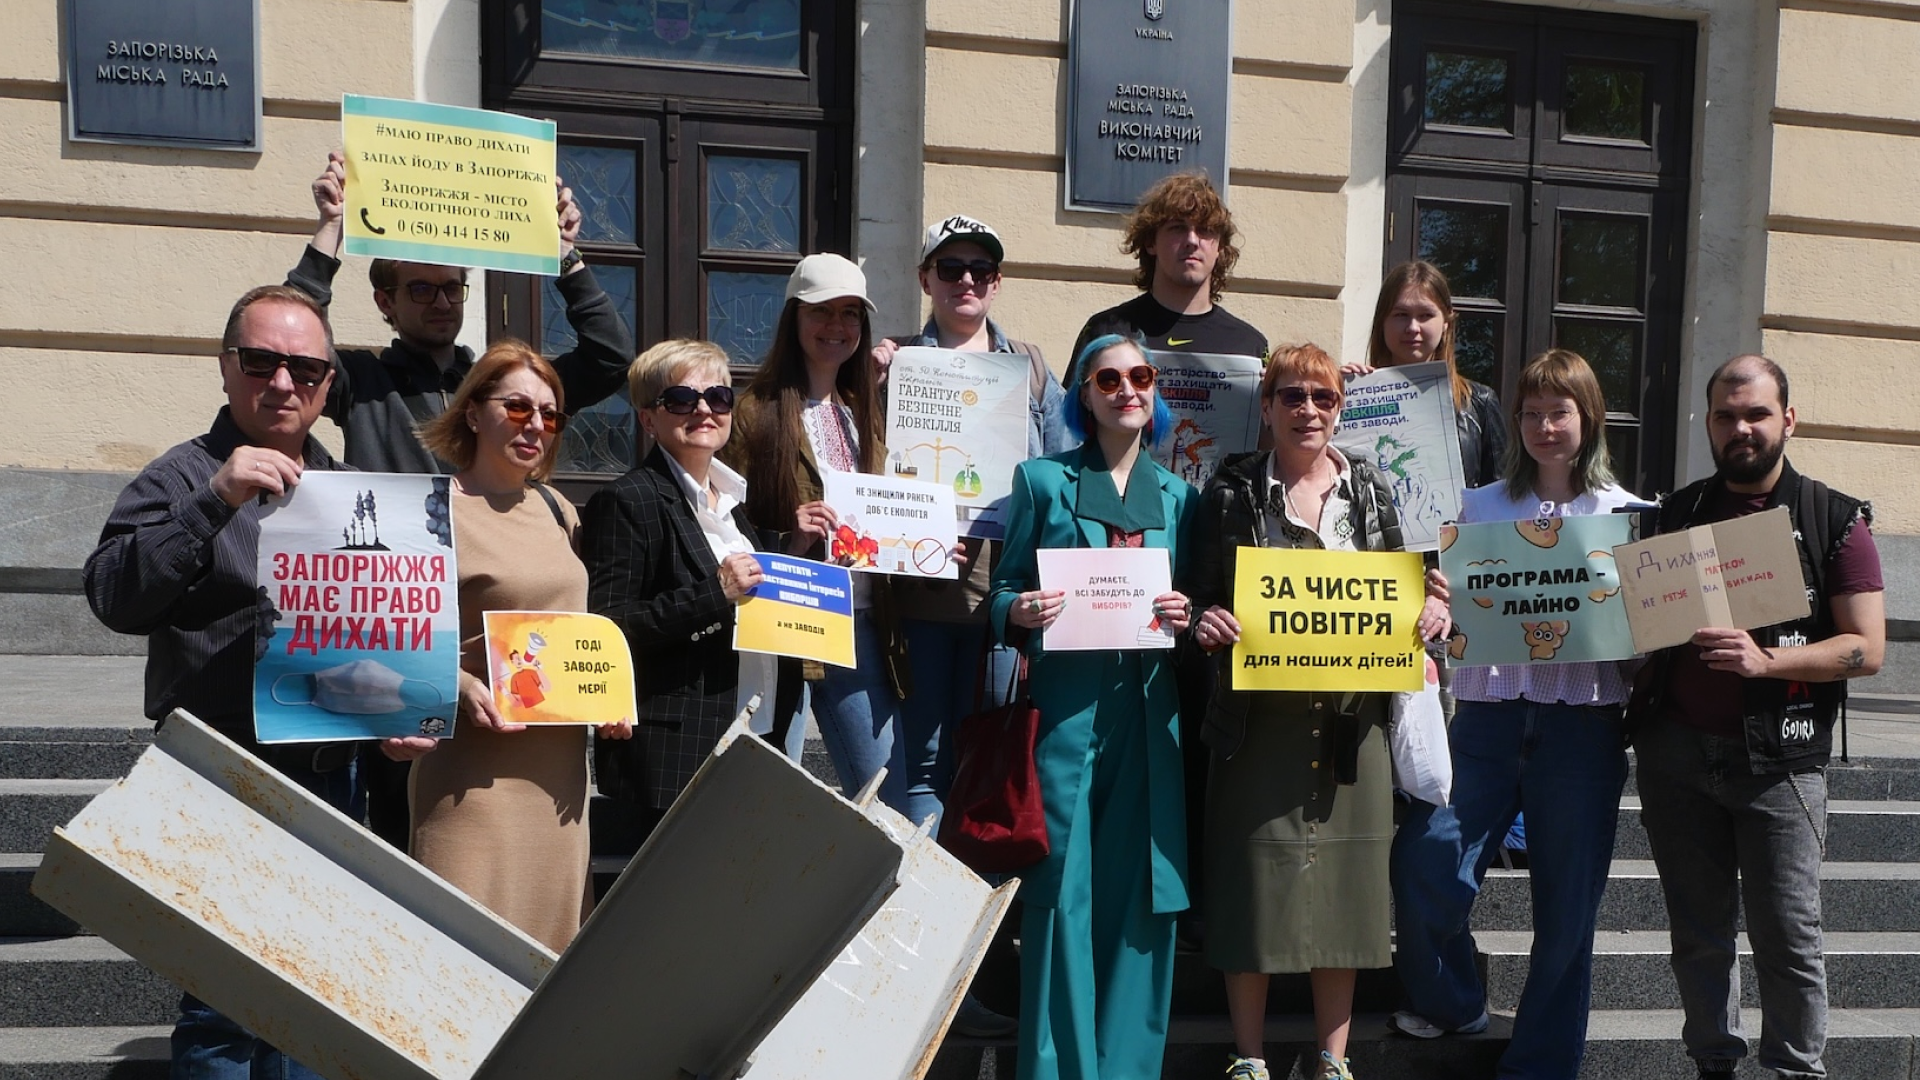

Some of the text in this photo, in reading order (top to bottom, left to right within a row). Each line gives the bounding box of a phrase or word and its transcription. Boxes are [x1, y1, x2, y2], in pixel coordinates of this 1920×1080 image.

[1135, 27, 1173, 40] УКРАЇНА
[108, 40, 218, 61] ЗАПОРІЗЬКА
[98, 65, 229, 87] МІСЬКА РАДА
[1117, 83, 1188, 100] ЗАПОРІЗЬКА
[1109, 100, 1195, 118] МІСЬКА РАДА
[1100, 119, 1202, 141] ВИКОНАВЧИЙ
[1117, 142, 1183, 161] КОМІТЕТ
[397, 219, 510, 243] 0 (50) 414 15 80
[898, 384, 960, 403] ГАРАНТУЄ
[1168, 379, 1232, 391] захищати
[1167, 401, 1216, 413] заводи.
[1357, 391, 1419, 406] захищати
[898, 399, 962, 418] БЕЗПЕЧНЕ
[896, 415, 962, 434] ДОВКІЛЛЯ
[1343, 415, 1410, 431] не заводи.
[855, 486, 938, 505] НЕ ЗНИЩИЛИ РАКЕТИ,
[890, 507, 928, 519] ЕКОЛОГІЯ
[273, 552, 446, 583] ЗАПОРІЖЖЯ
[1260, 575, 1398, 601] ЗА ЧИСТЕ
[1467, 568, 1590, 590] ПРОГРАМА
[279, 584, 441, 614] МАЄ ПРАВО
[1075, 588, 1146, 598] ВСІ ЗАБУДУТЬ ДО
[1641, 597, 1656, 609] НЕ
[1726, 571, 1775, 588] ВИКИДІВ
[1092, 601, 1132, 610] ВИБОРІВ?
[1502, 593, 1580, 616] ЛАЙНО
[794, 622, 825, 635] ЗАВОДІВ
[1269, 611, 1392, 636] ПОВІТРЯ
[287, 615, 432, 656] ДИХАТИ
[575, 639, 601, 652] ГОДІ
[563, 661, 616, 674] ЗАВОДО-
[1244, 652, 1413, 670] для наших дітей!
[578, 681, 607, 695] МЕРІЇ
[1781, 717, 1815, 741] GOJIRA
